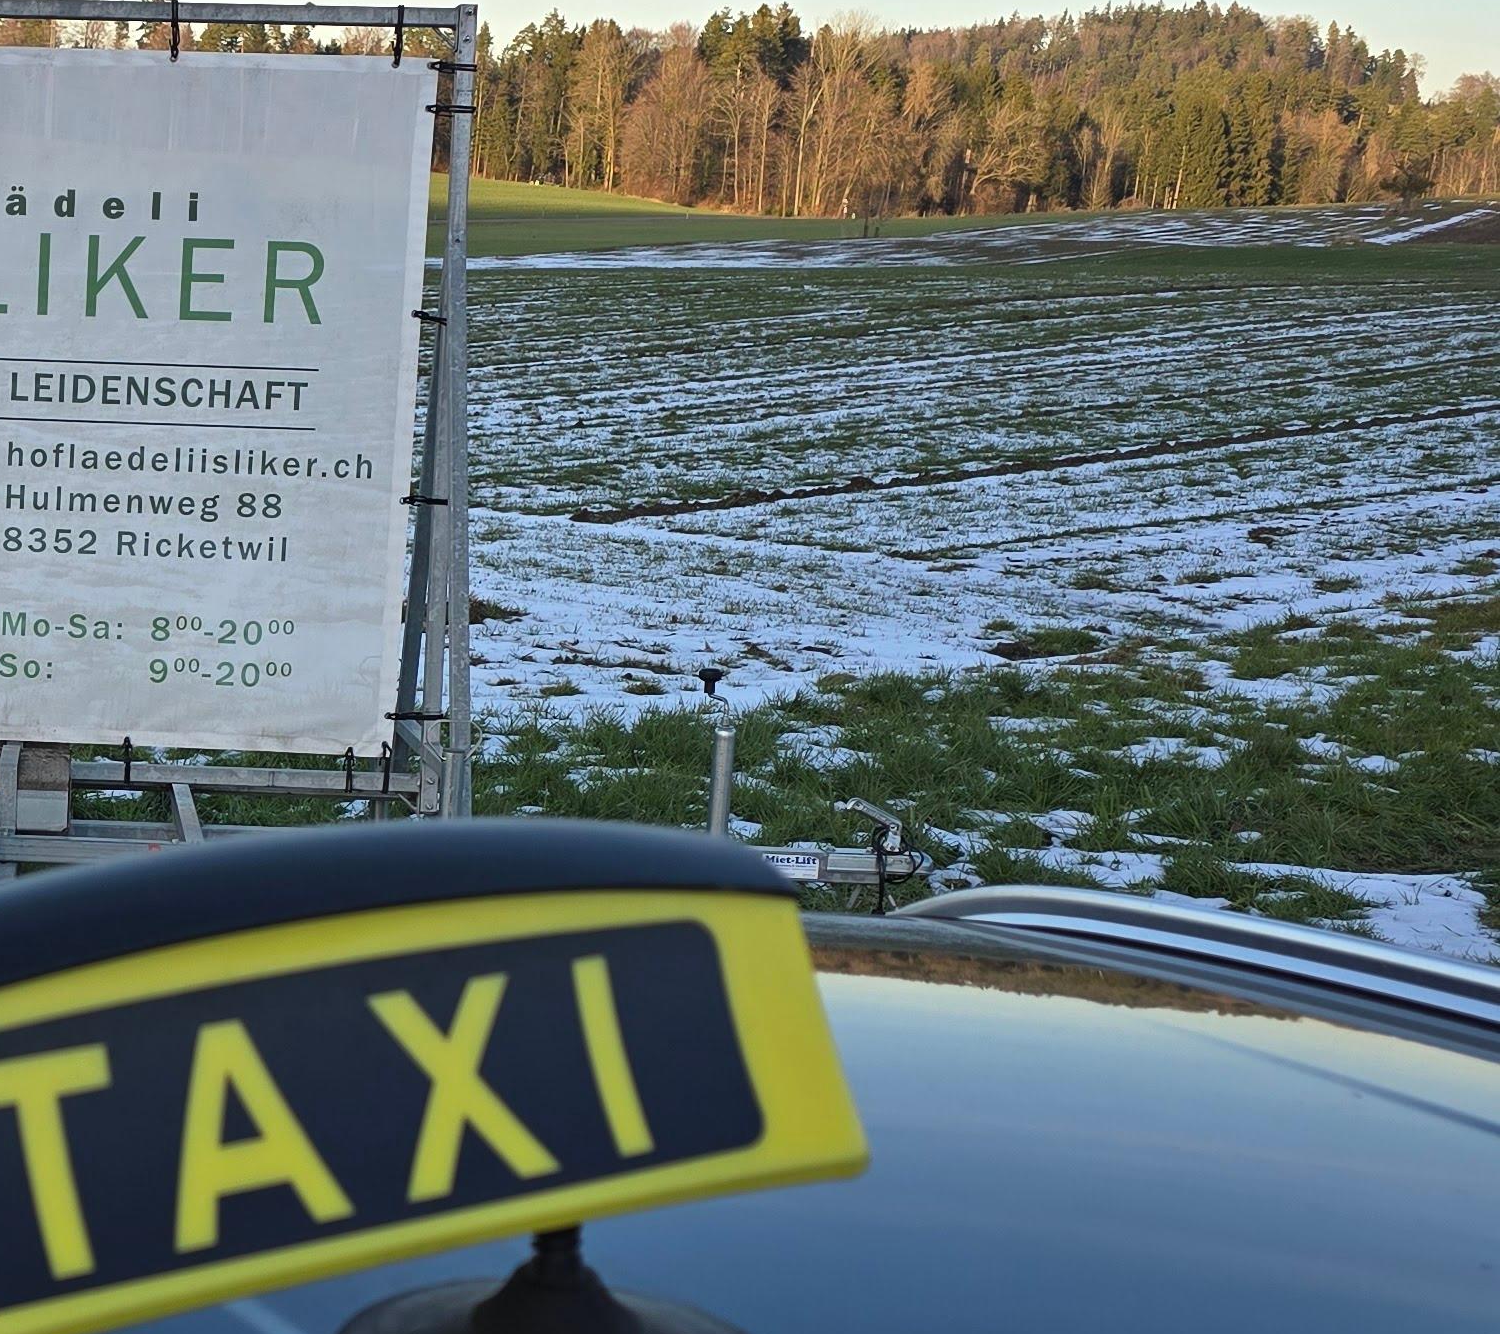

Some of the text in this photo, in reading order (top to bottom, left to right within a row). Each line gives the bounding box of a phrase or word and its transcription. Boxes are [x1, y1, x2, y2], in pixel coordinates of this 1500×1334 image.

[11, 372, 308, 410] LEIDENSCHAFT
[8, 441, 372, 479] hoflaedeliisliker.ch
[6, 484, 281, 522] Hulmenweg 88
[3, 527, 287, 562] 8352 Ricketwil
[2, 612, 122, 639] Mo-Sa:
